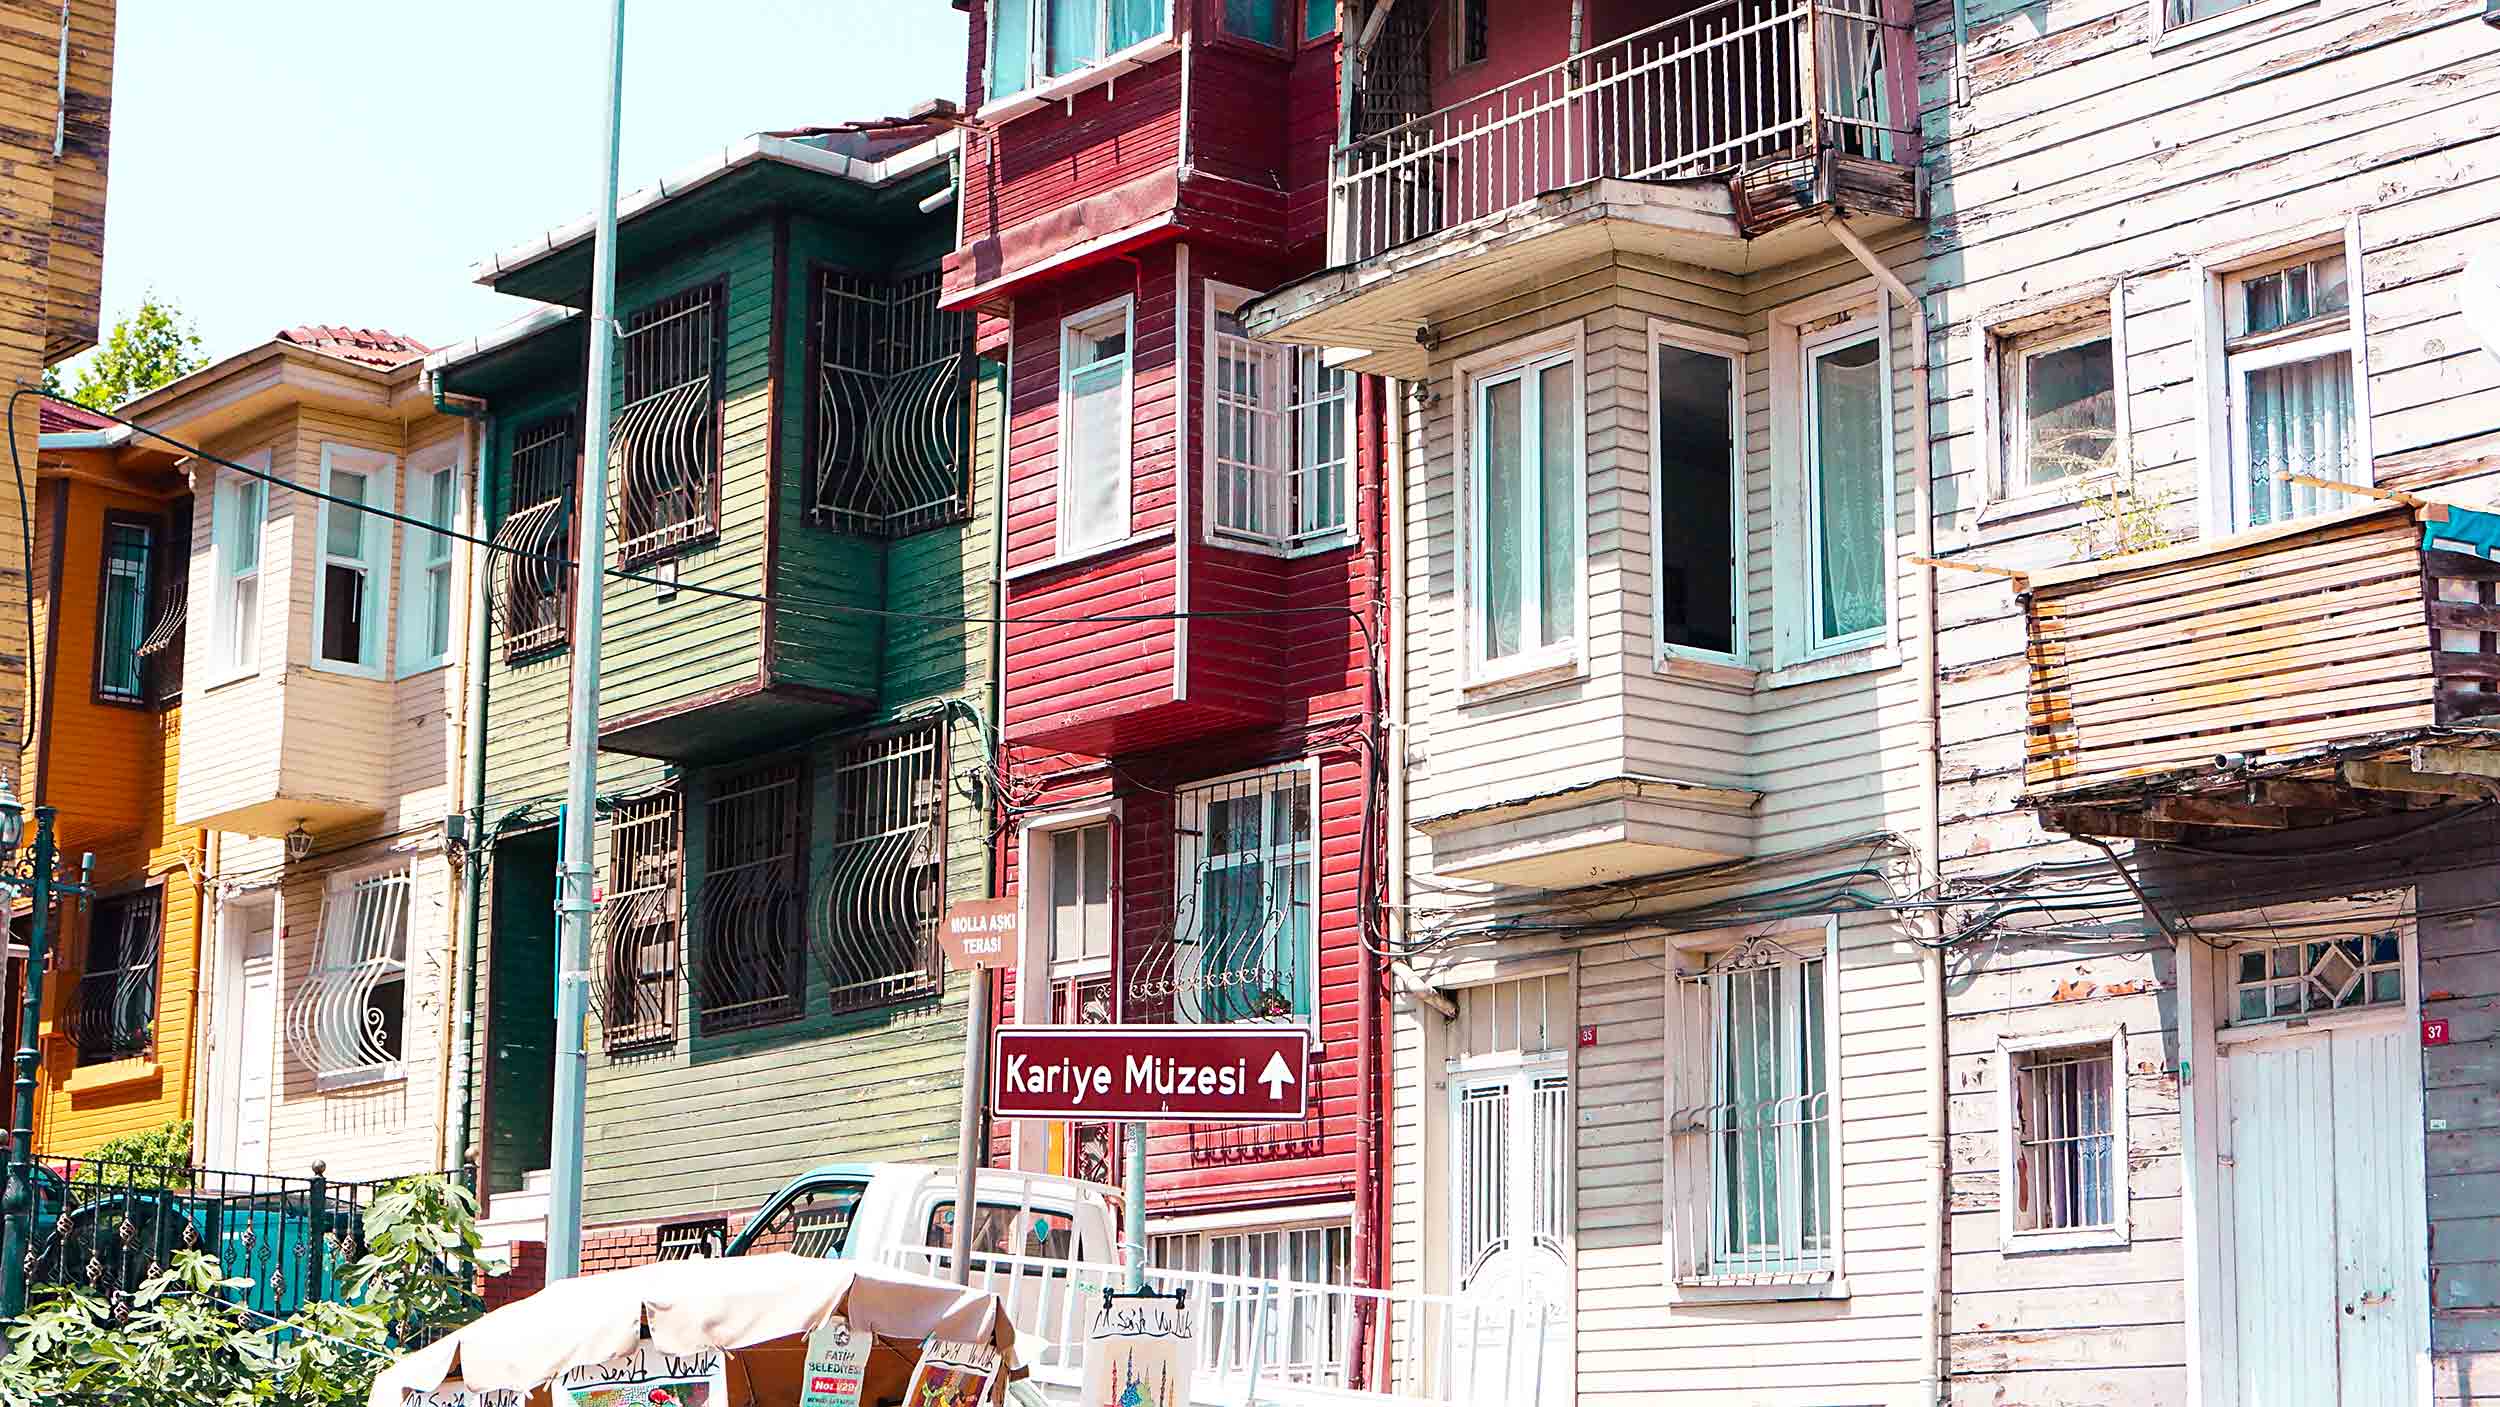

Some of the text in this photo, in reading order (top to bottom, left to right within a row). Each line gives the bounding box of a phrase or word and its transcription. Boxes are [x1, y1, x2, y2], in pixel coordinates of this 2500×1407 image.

[951, 915, 987, 934] MOLLA
[1583, 1030, 1593, 1041] 35
[2428, 1025, 2442, 1039] 37
[1006, 1053, 1246, 1105] Kariye Müzesi
[815, 1380, 834, 1391] No:
